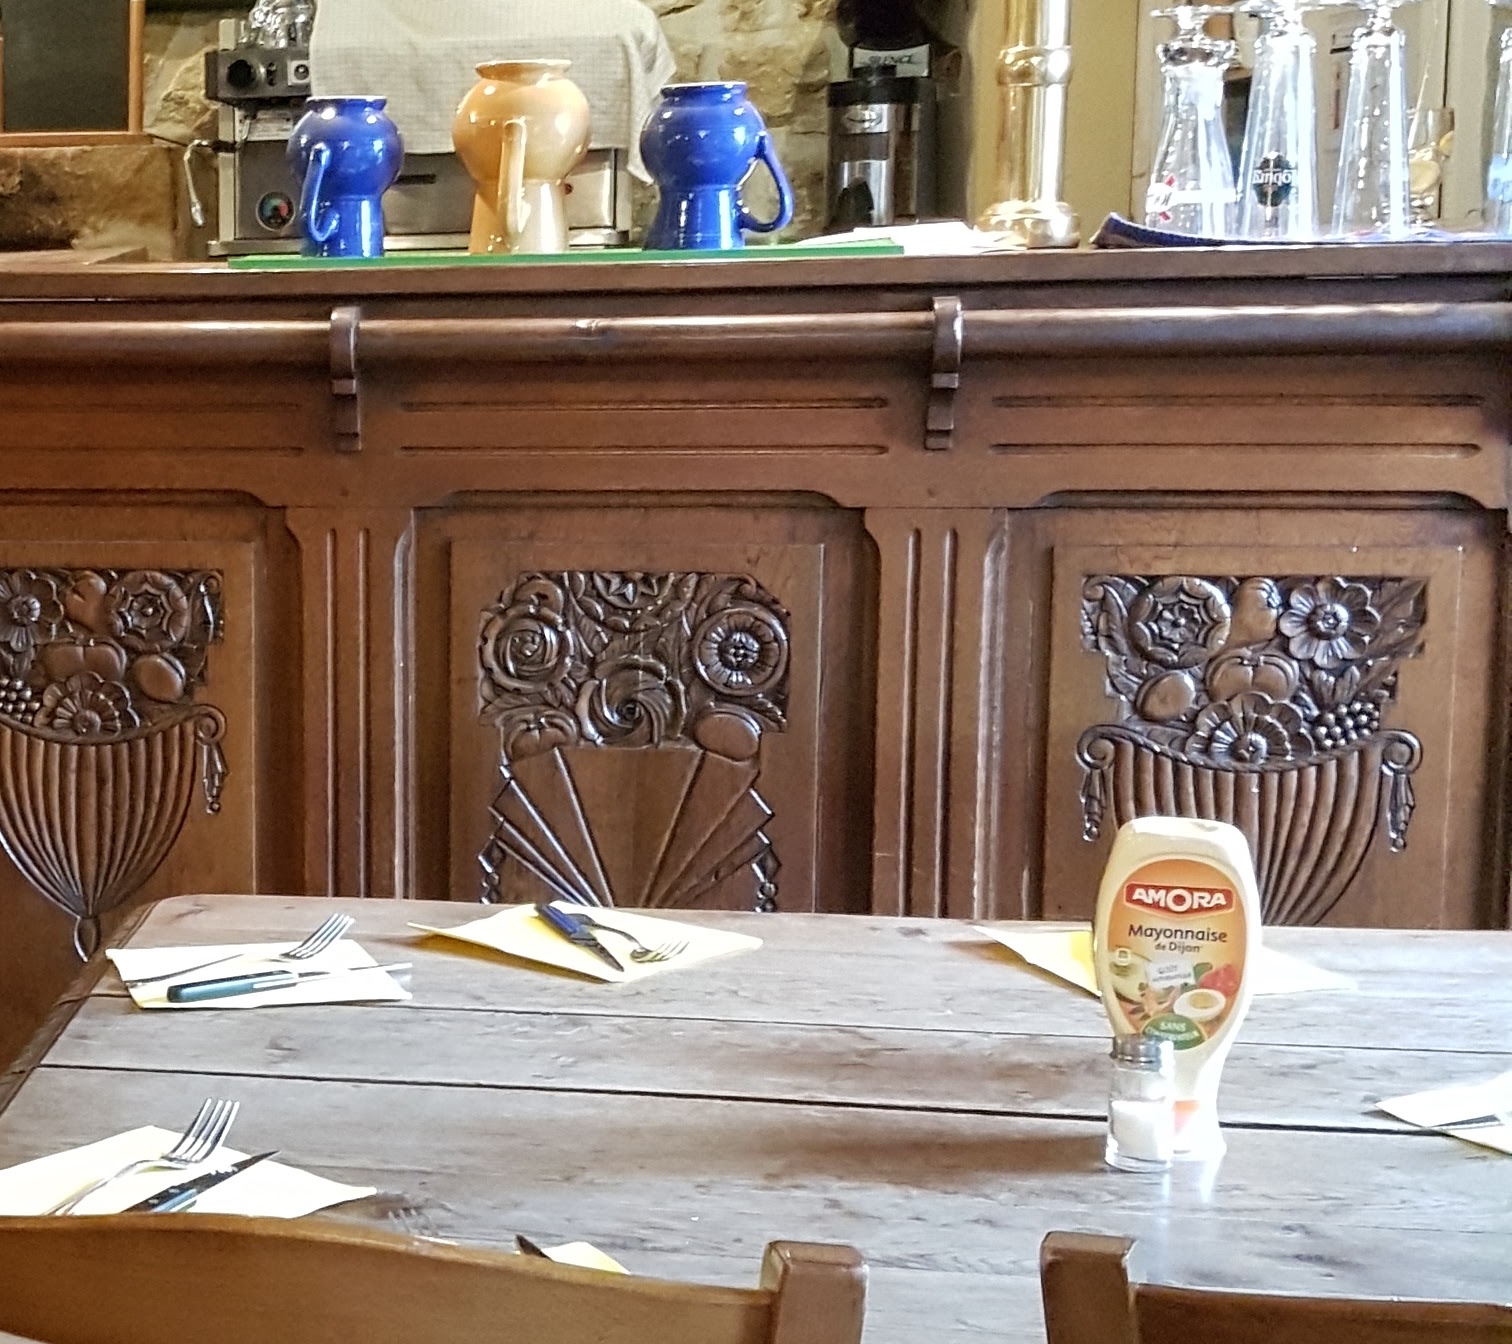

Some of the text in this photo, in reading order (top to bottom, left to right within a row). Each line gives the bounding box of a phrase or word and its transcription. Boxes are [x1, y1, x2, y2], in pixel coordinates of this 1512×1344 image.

[1131, 888, 1227, 912] AMORA
[1128, 923, 1228, 943] Mayonnaise
[1155, 941, 1201, 955] de Dijon
